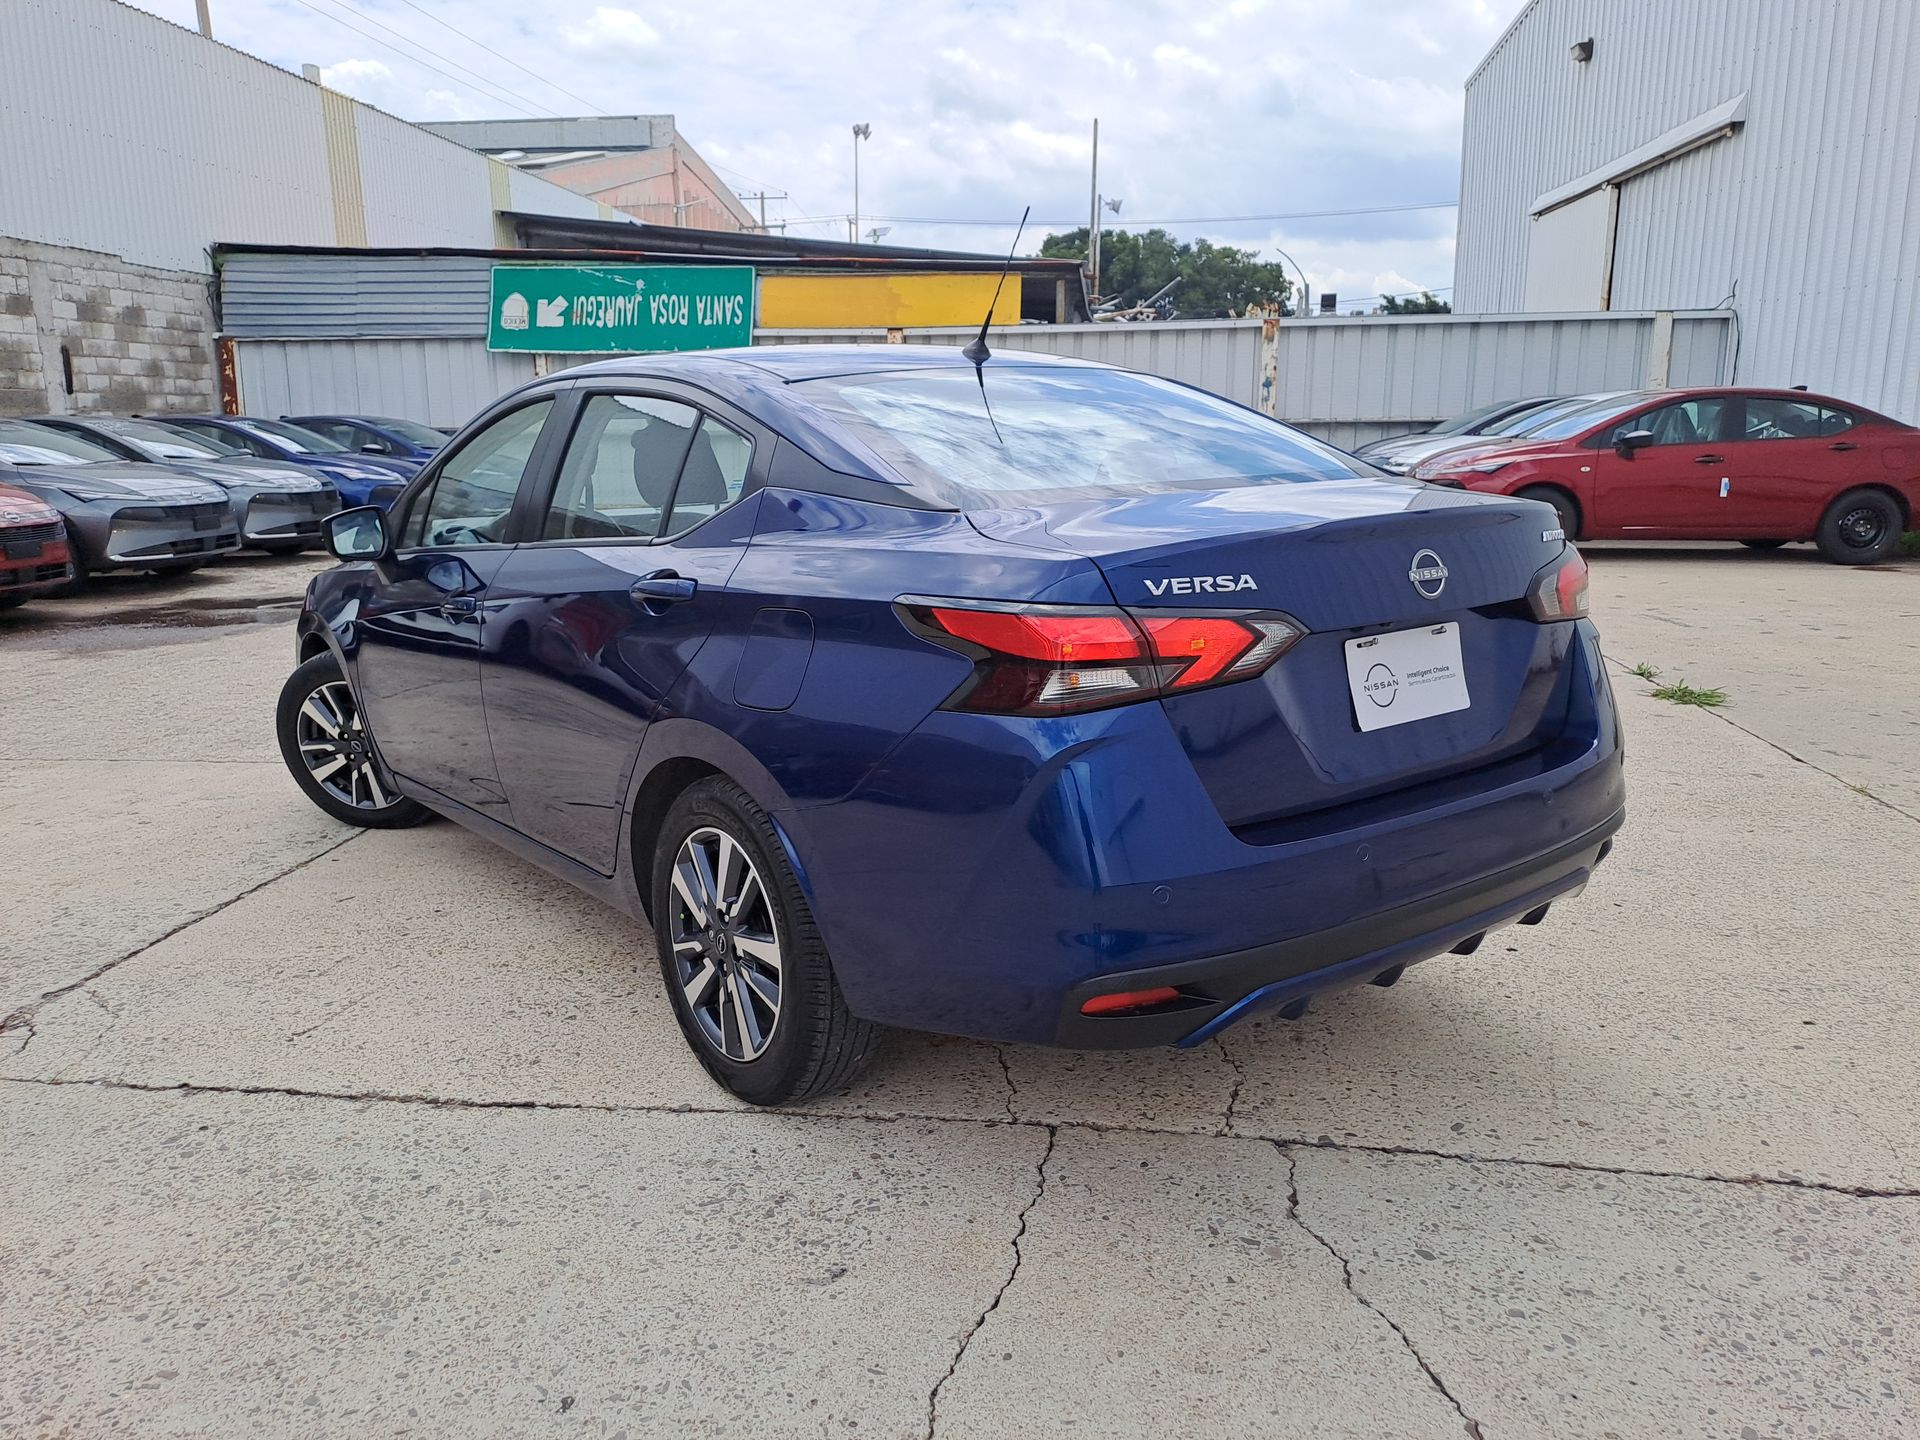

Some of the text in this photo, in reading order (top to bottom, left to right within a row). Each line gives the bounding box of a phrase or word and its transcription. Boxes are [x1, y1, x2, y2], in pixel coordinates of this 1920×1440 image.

[572, 294, 743, 328] SANTA ROSA JAUREGUI
[1410, 568, 1448, 581] NISSAN
[1143, 574, 1259, 596] VERSA
[1406, 665, 1450, 679] Intelligent Choice
[1363, 679, 1399, 692] NISSAN
